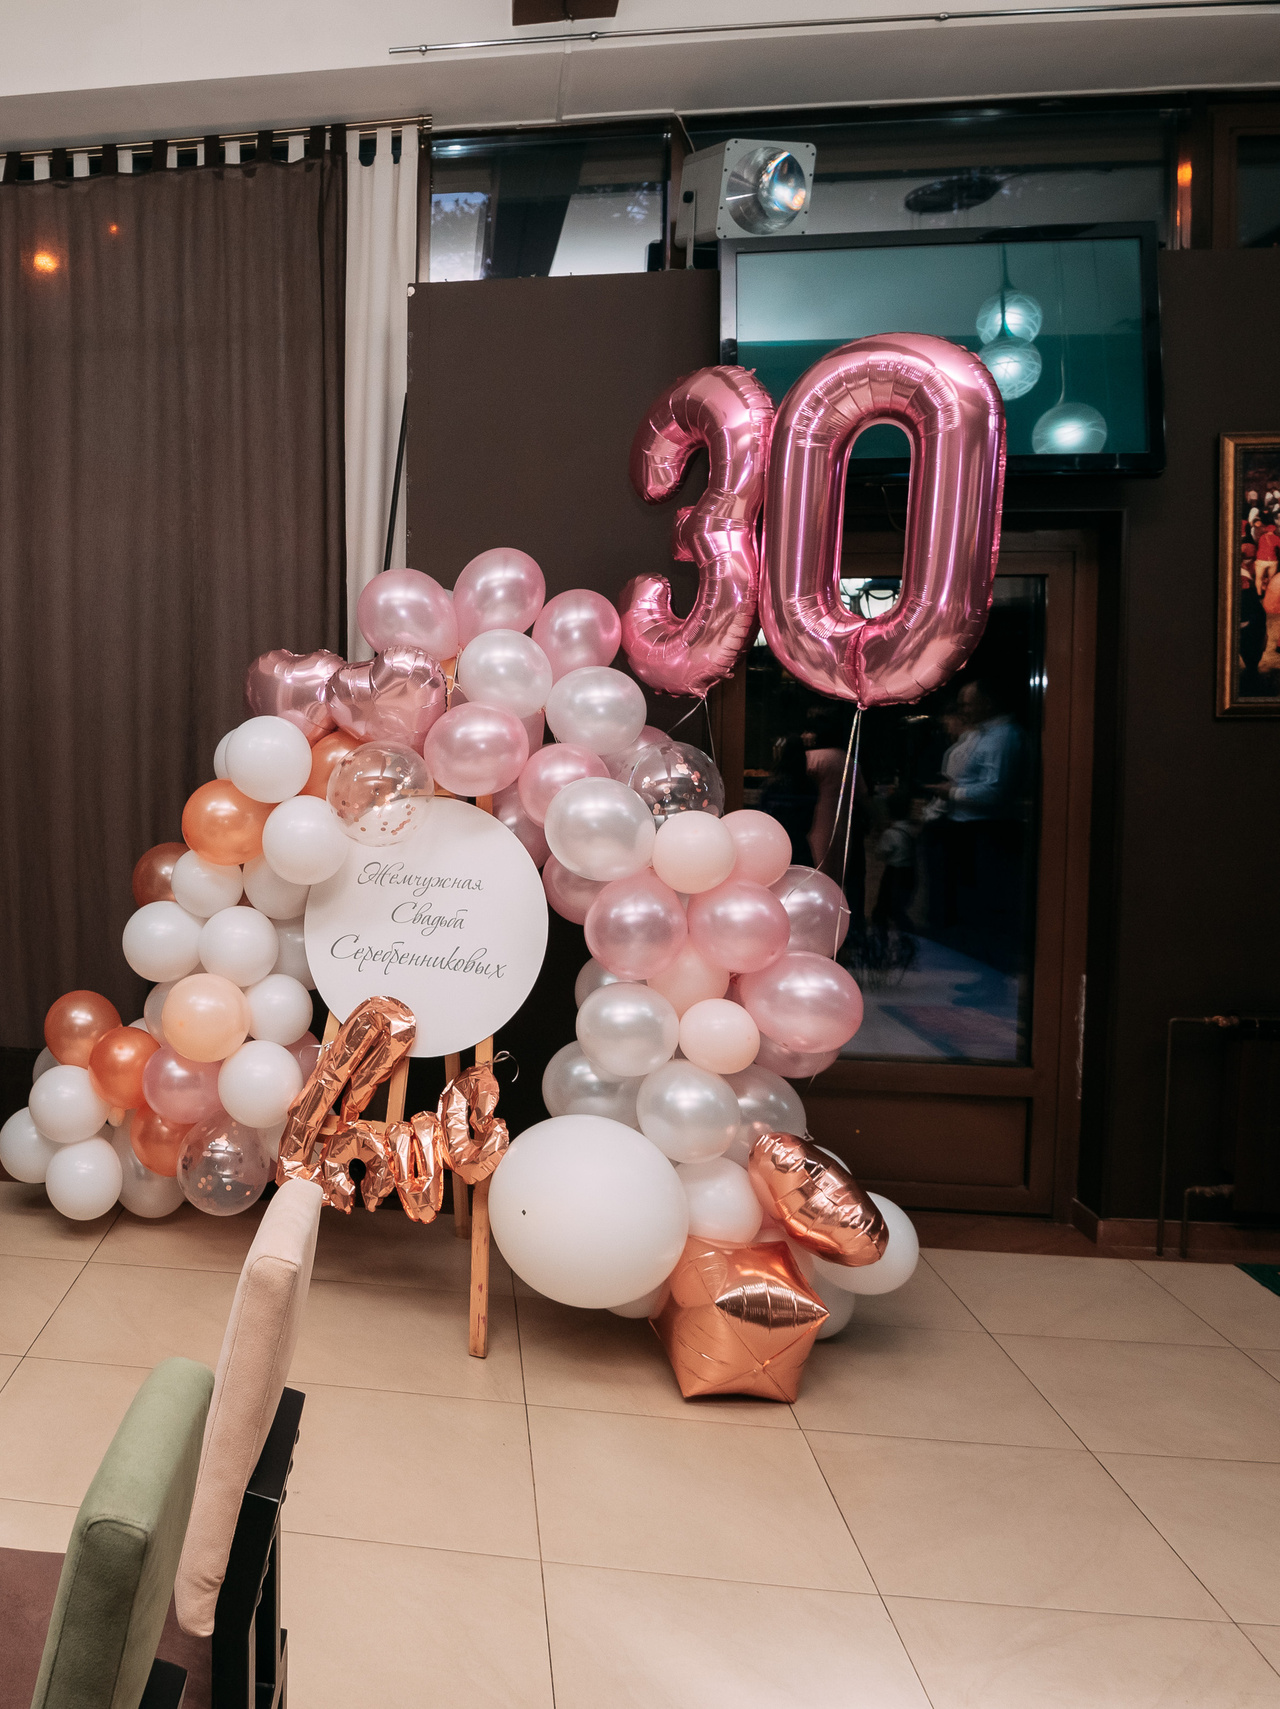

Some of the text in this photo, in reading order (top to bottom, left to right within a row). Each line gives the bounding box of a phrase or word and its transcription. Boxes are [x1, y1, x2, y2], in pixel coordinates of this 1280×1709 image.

[621, 332, 1008, 709] 30
[357, 861, 484, 897] Жемчужная
[391, 901, 468, 937] Свадьба
[330, 934, 508, 979] Серебренниковых
